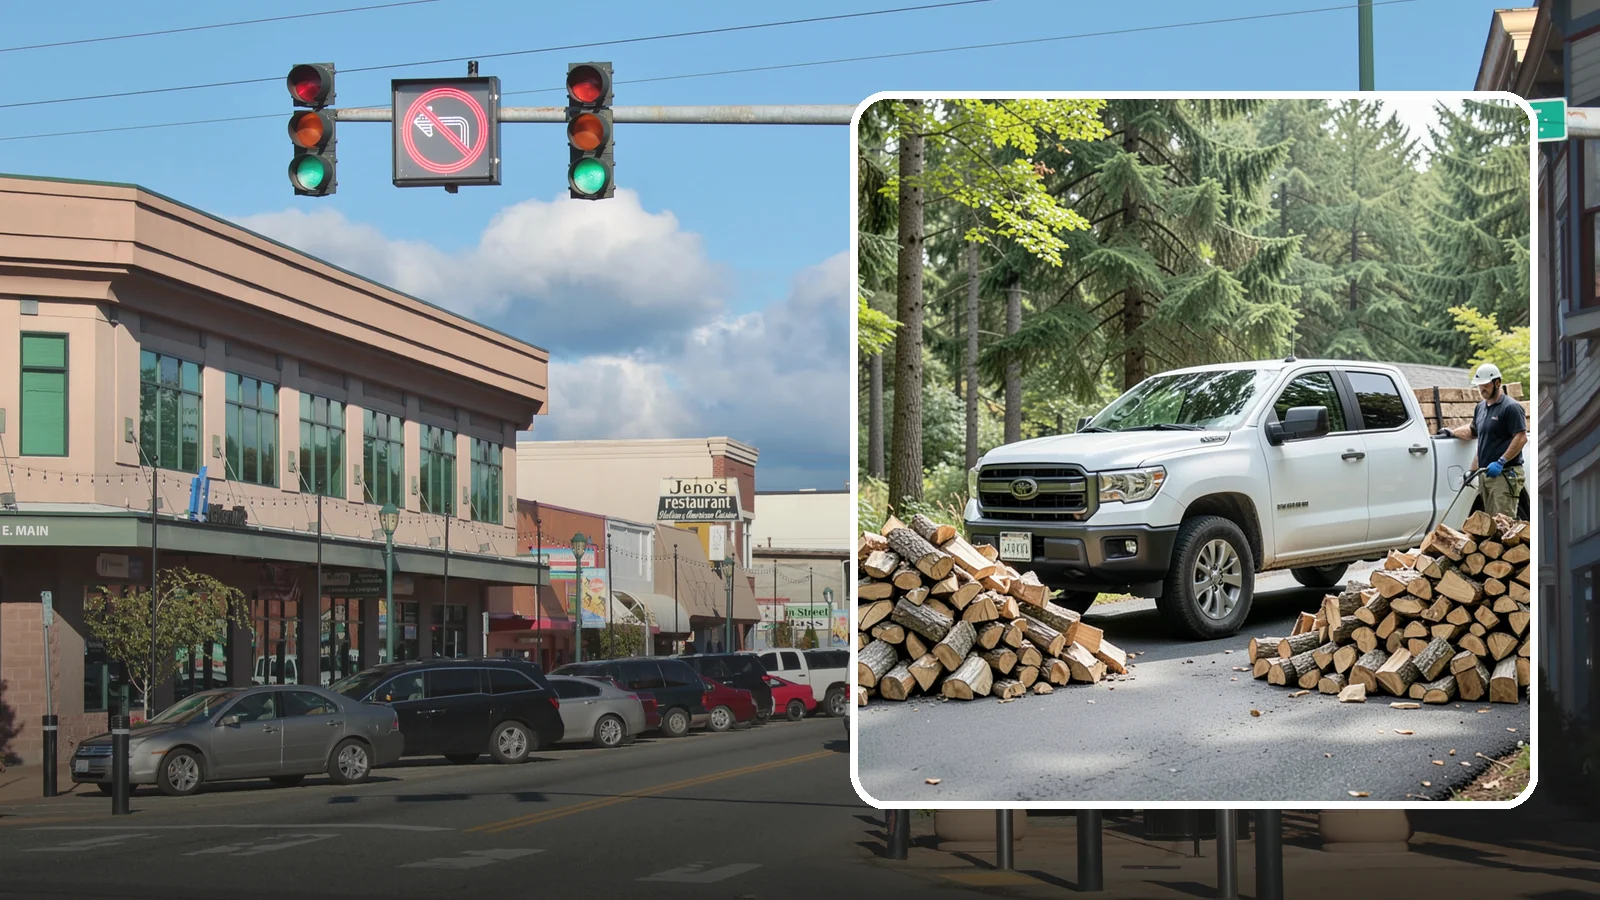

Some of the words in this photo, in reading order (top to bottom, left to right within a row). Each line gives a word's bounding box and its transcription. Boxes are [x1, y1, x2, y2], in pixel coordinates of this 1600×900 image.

[670, 480, 728, 494] Jeno's
[665, 496, 731, 509] restaurant
[686, 509, 714, 519] American
[715, 509, 737, 519] Cuisine
[2, 525, 13, 536] E.
[15, 525, 49, 536] MAIN
[798, 607, 828, 617] Street
